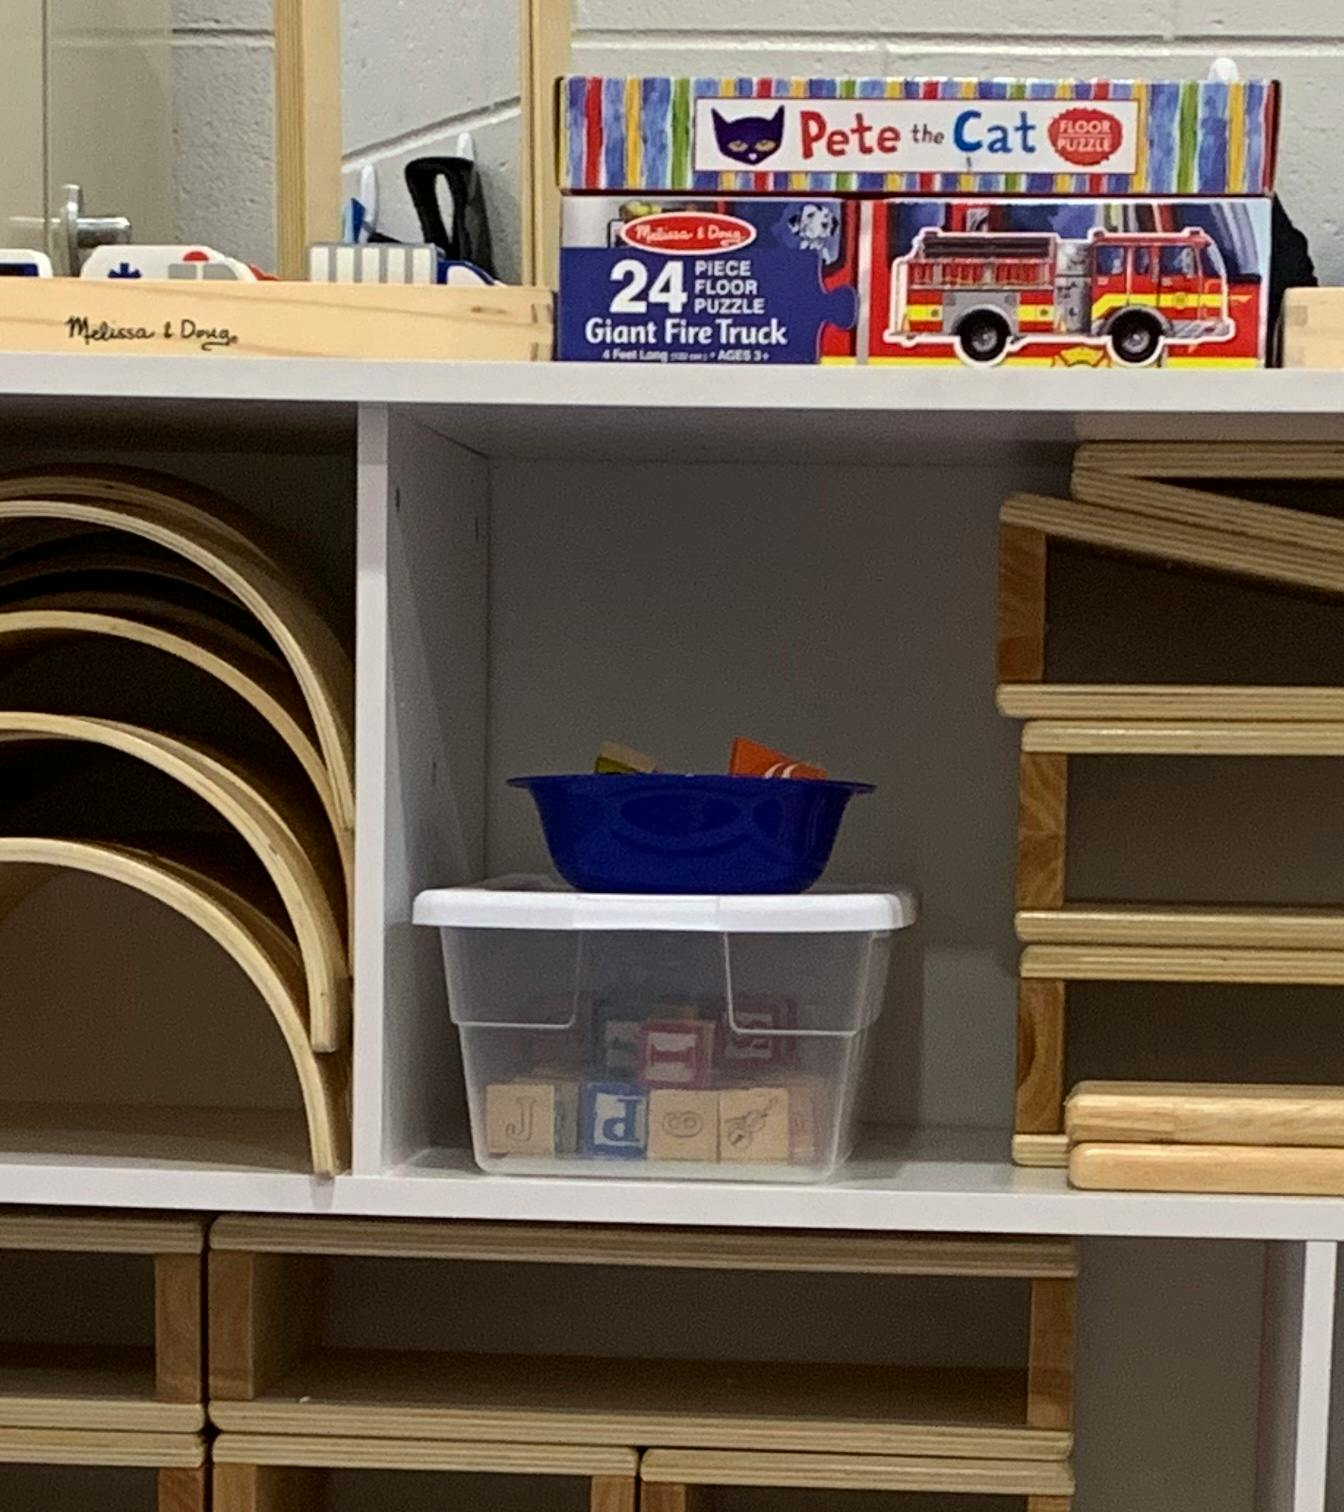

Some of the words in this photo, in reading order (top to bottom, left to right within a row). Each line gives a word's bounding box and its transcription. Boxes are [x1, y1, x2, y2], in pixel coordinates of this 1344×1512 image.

[799, 109, 901, 159] Pete
[911, 123, 945, 145] the
[953, 109, 1037, 153] Cat
[1058, 119, 1112, 133] FLOOR
[1057, 137, 1112, 152] PUZZLE
[635, 224, 694, 246] Melissa
[707, 224, 744, 247] Doug
[694, 260, 752, 277] PIECE
[608, 258, 688, 314] 24
[694, 279, 758, 295] FLOOR
[693, 298, 766, 315] PUZZLE
[65, 315, 156, 346] Melissa
[585, 316, 657, 345] Giant
[664, 318, 713, 345] Fire
[714, 317, 788, 346] Truck
[717, 350, 752, 361] AGES
